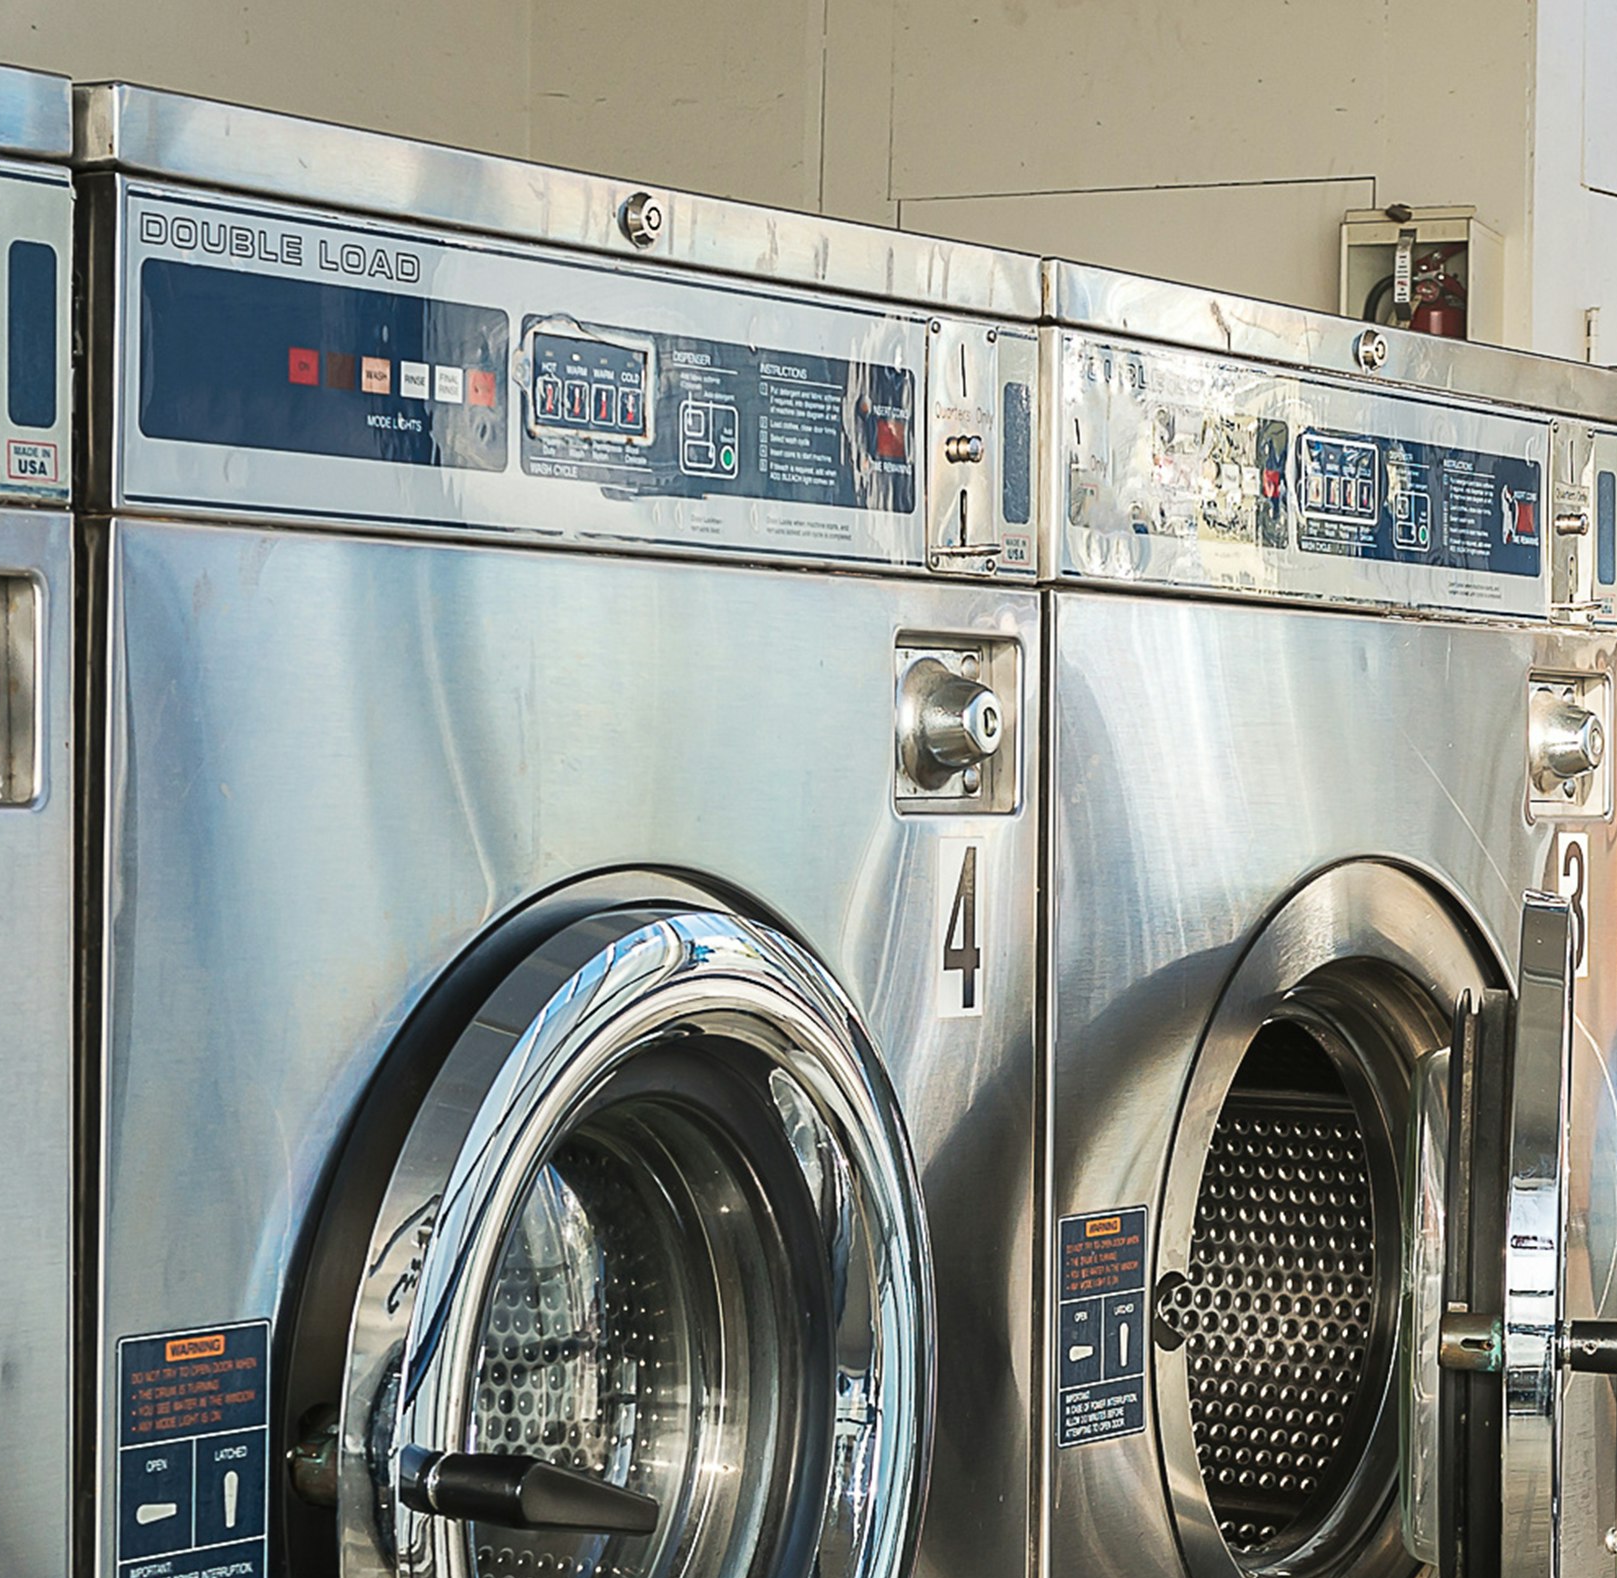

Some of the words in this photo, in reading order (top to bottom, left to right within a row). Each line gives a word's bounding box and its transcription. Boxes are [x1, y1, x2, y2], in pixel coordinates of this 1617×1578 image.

[140, 212, 303, 266] DOUBLE
[320, 240, 420, 283] LOAD
[367, 415, 391, 428] MODE
[13, 445, 39, 458] MADE
[41, 448, 51, 459] IN
[18, 459, 48, 476] USA
[1007, 548, 1025, 561] USA
[1563, 841, 1584, 970] 3
[943, 846, 980, 1008] 4
[170, 1339, 220, 1356] WARNING
[214, 1446, 248, 1461] LATCHED
[146, 1459, 168, 1473] OPEN
